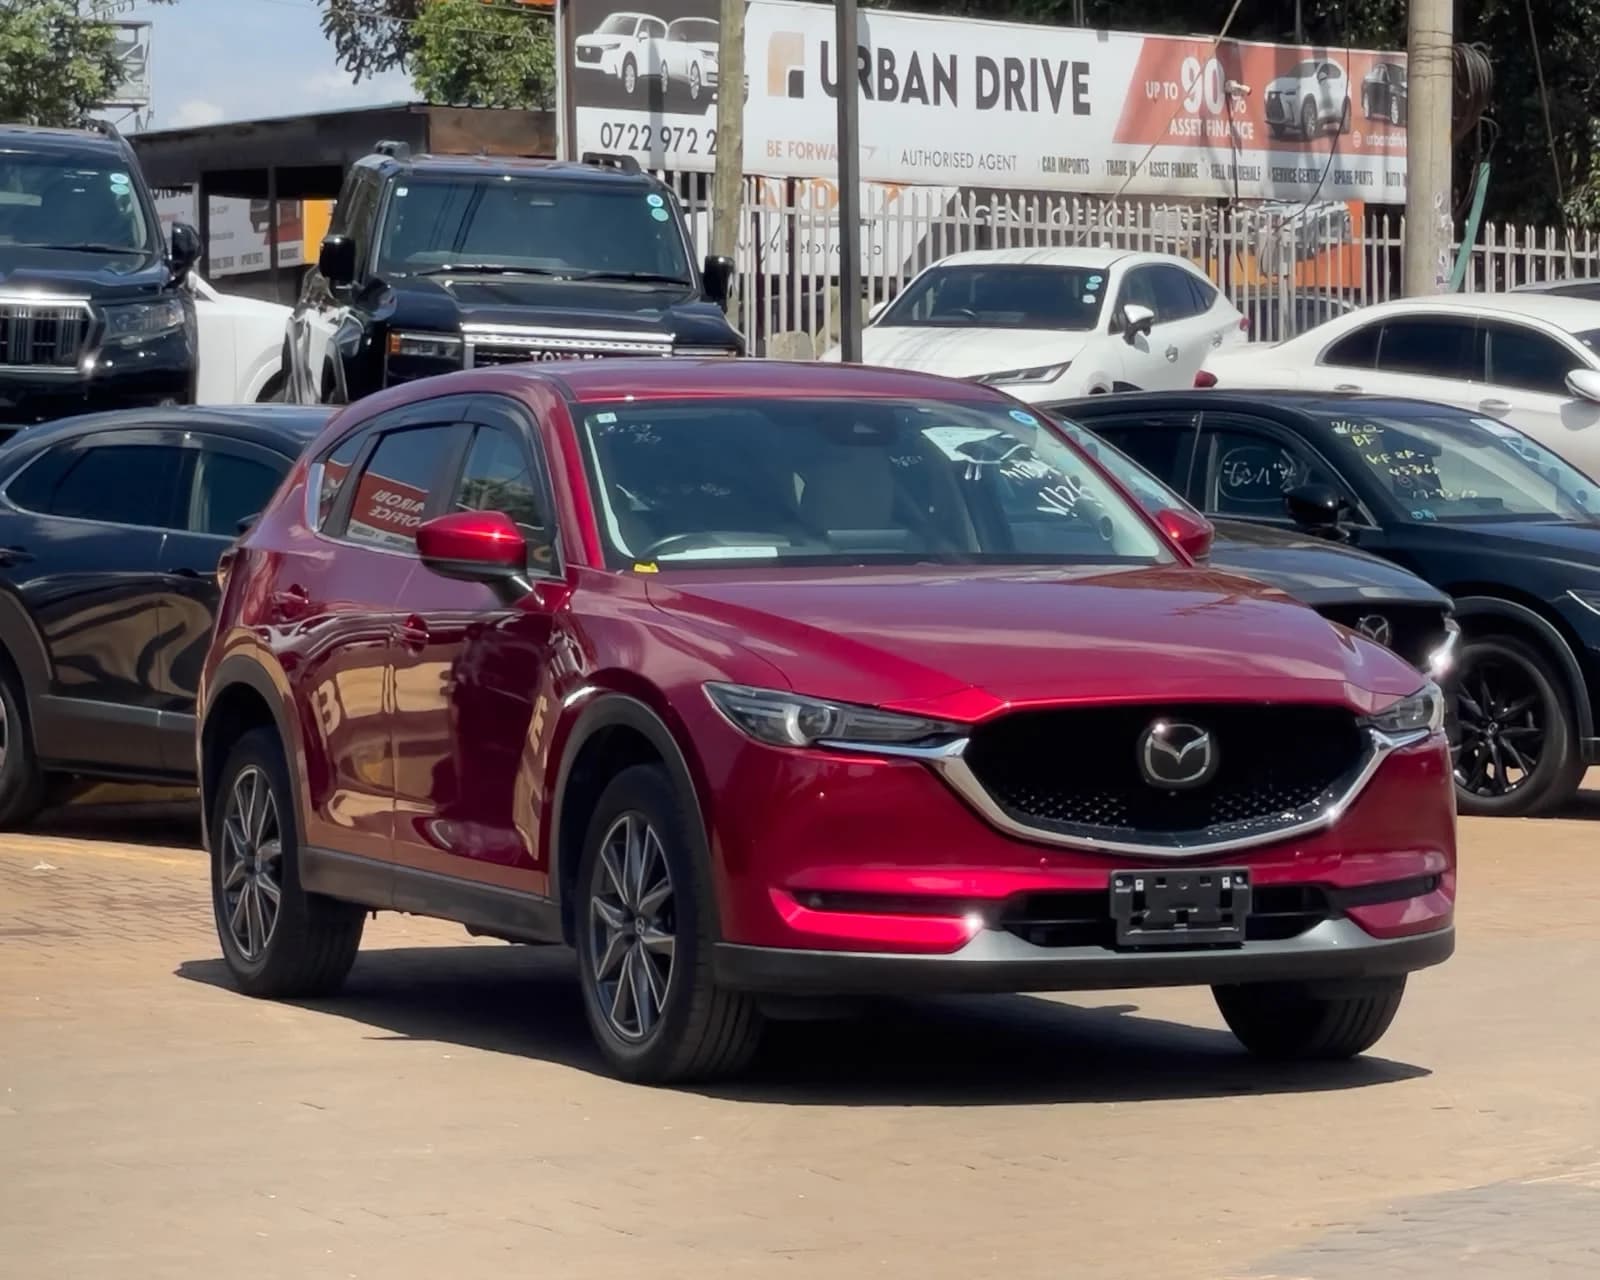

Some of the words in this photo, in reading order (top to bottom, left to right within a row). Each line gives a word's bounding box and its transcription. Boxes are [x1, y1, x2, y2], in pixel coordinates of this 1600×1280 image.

[820, 41, 958, 108] URBAN
[976, 56, 1092, 115] DRIVE
[1145, 81, 1160, 98] UP
[1163, 82, 1178, 99] TO
[600, 122, 652, 151] 0722
[660, 127, 698, 153] 972
[1169, 118, 1202, 136] ASSET
[1205, 120, 1254, 140] FINANCE
[767, 139, 782, 157] BE
[788, 140, 838, 161] FORWA
[901, 150, 974, 168] AUTHORISED
[978, 153, 1017, 170] AGENT
[1042, 156, 1056, 173] CAR
[1058, 157, 1090, 174] IMPORTS
[1106, 160, 1127, 176] TRADE
[1150, 161, 1169, 178] ASSET
[1051, 207, 1137, 228] OFFCE
